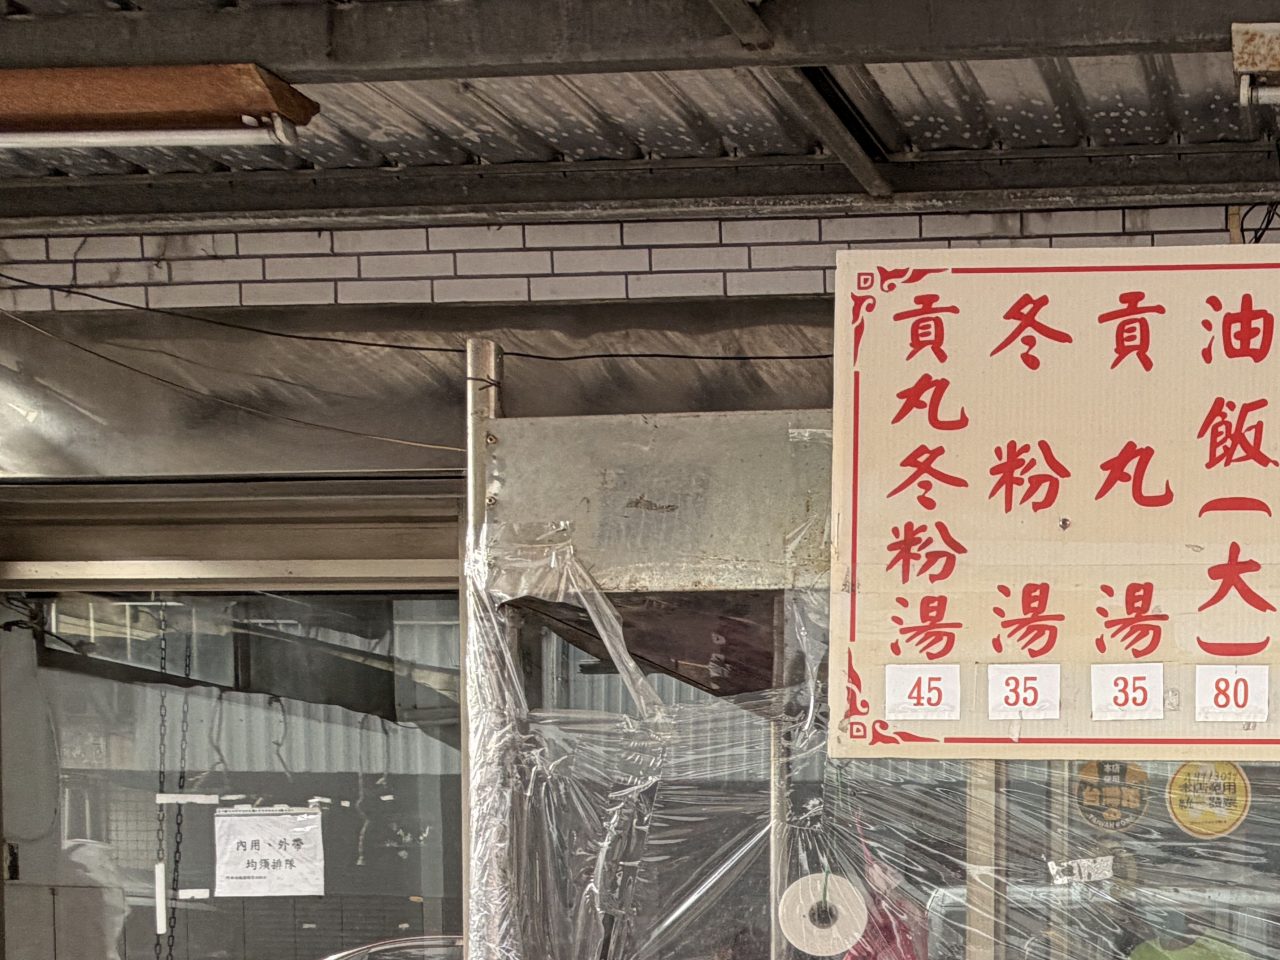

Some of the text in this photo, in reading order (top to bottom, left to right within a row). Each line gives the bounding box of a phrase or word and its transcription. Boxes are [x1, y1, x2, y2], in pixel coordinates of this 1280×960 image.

[886, 293, 970, 661] 貢丸冬粉湯
[989, 293, 1074, 659] 冬粉湯
[1096, 290, 1174, 660] 貢丸湯
[908, 677, 943, 707] 45
[1004, 676, 1039, 707] 35
[1112, 676, 1148, 707] 35
[1213, 677, 1249, 708] 80
